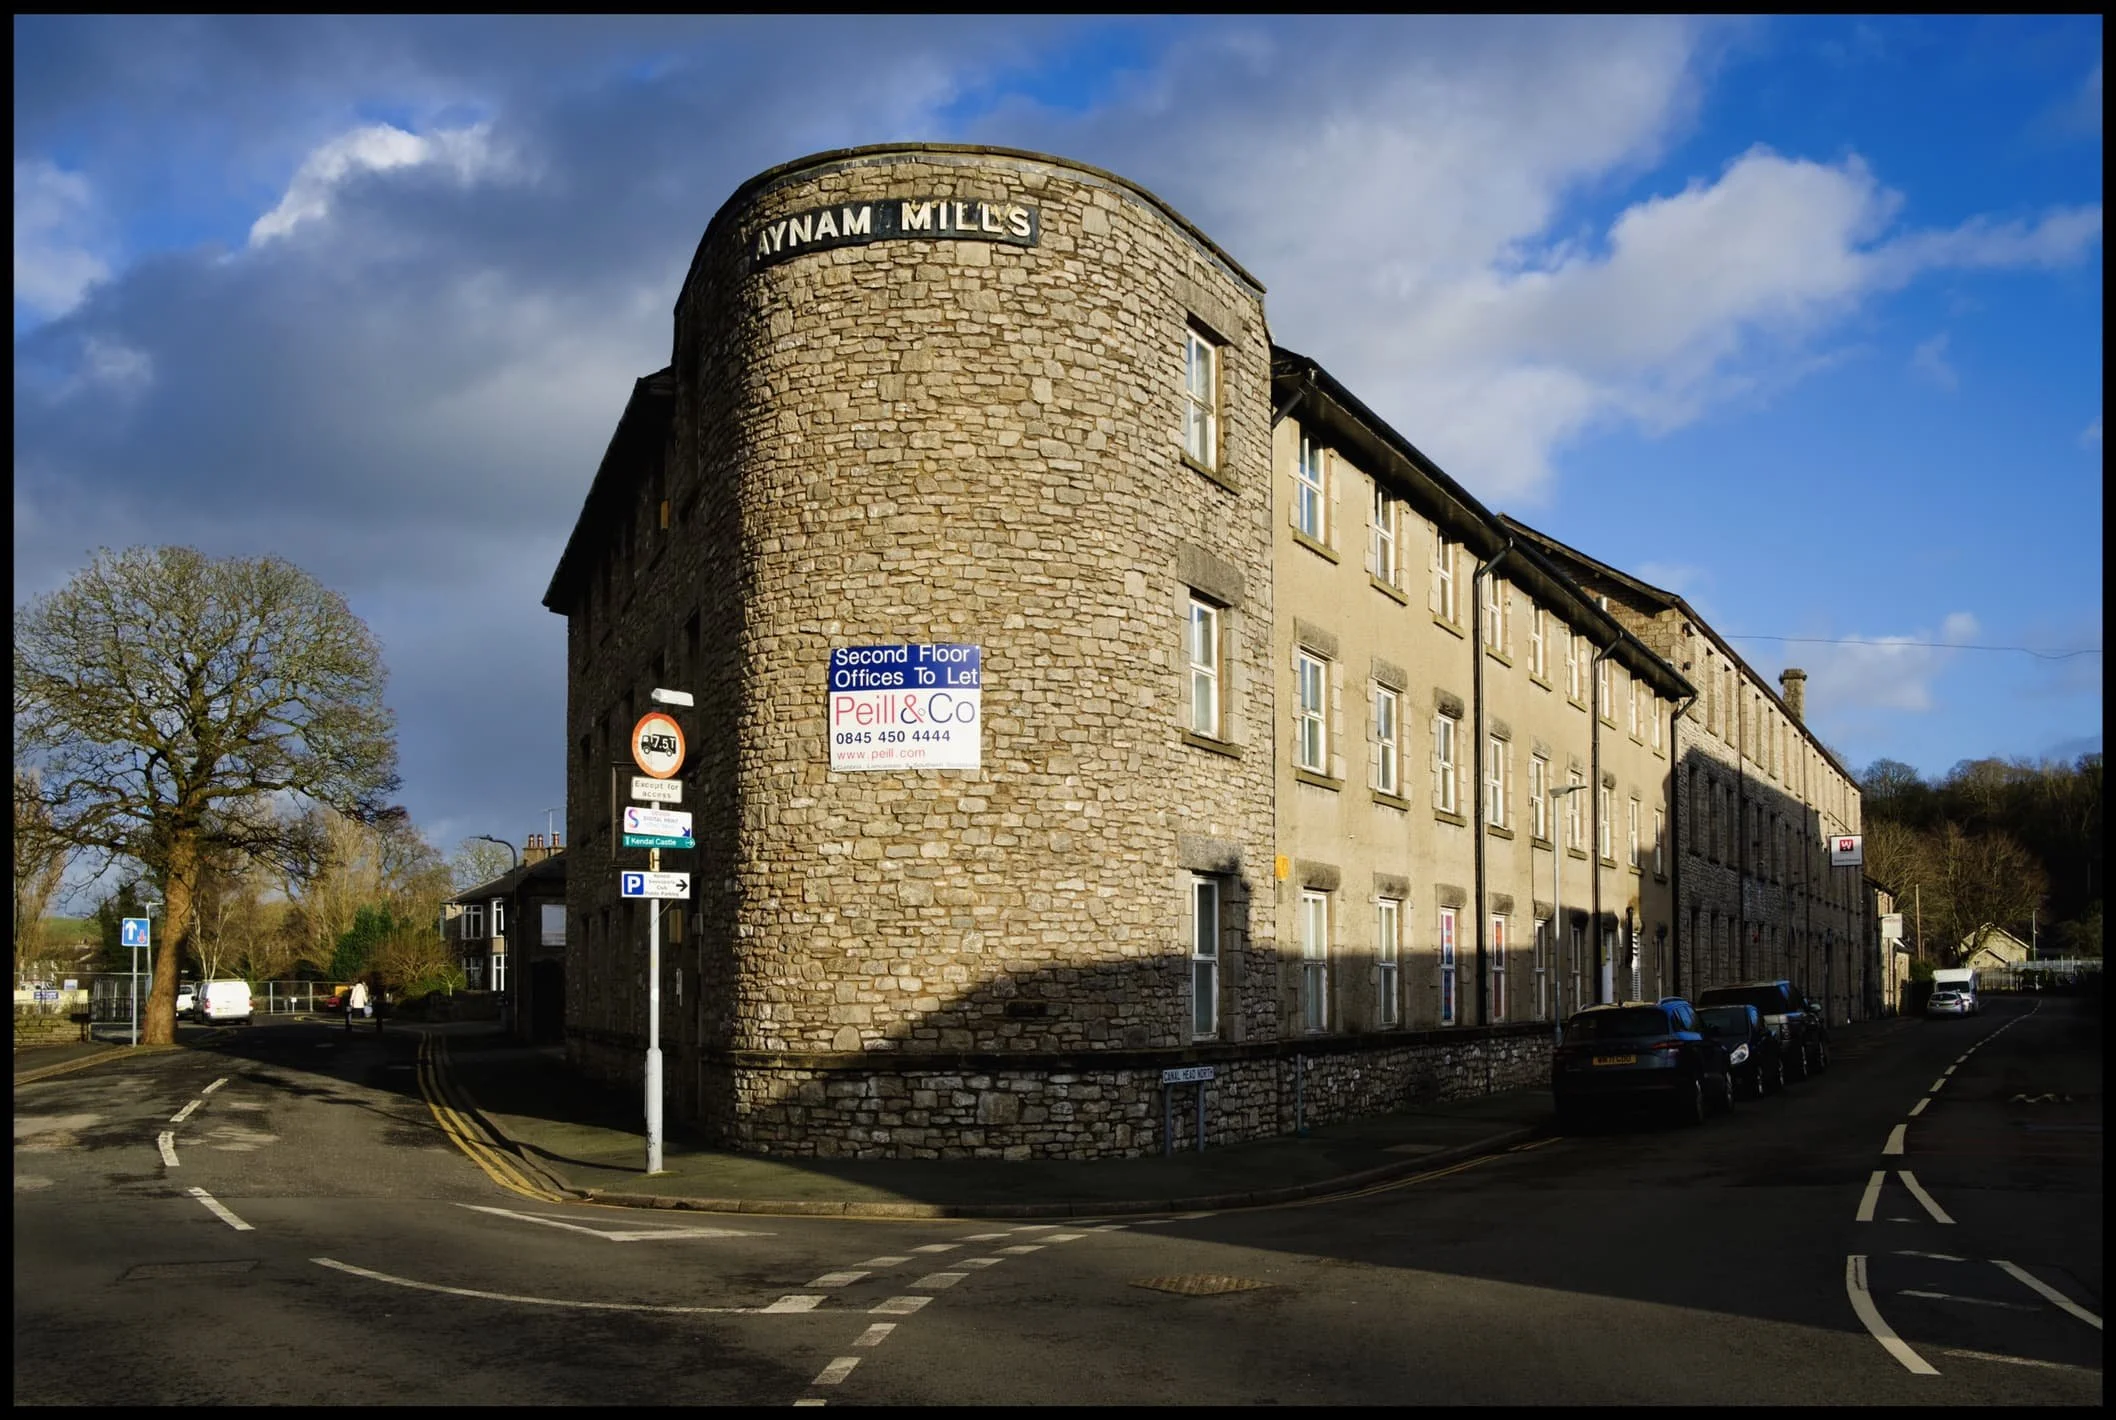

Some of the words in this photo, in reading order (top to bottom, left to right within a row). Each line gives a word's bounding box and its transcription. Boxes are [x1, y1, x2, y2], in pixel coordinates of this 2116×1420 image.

[756, 205, 872, 261] AYNAM
[901, 201, 1031, 237] MILLS
[835, 644, 908, 666] Second
[919, 645, 970, 663] Floor
[835, 669, 904, 688] Offices
[914, 667, 936, 685] To
[947, 667, 978, 685] Let
[836, 731, 872, 745] 0845
[878, 730, 905, 743] 450
[912, 730, 950, 742] 4444
[635, 780, 664, 790] Except
[667, 783, 679, 791] for
[642, 791, 672, 799] access
[631, 838, 654, 846] Kendal
[627, 875, 641, 893] P
